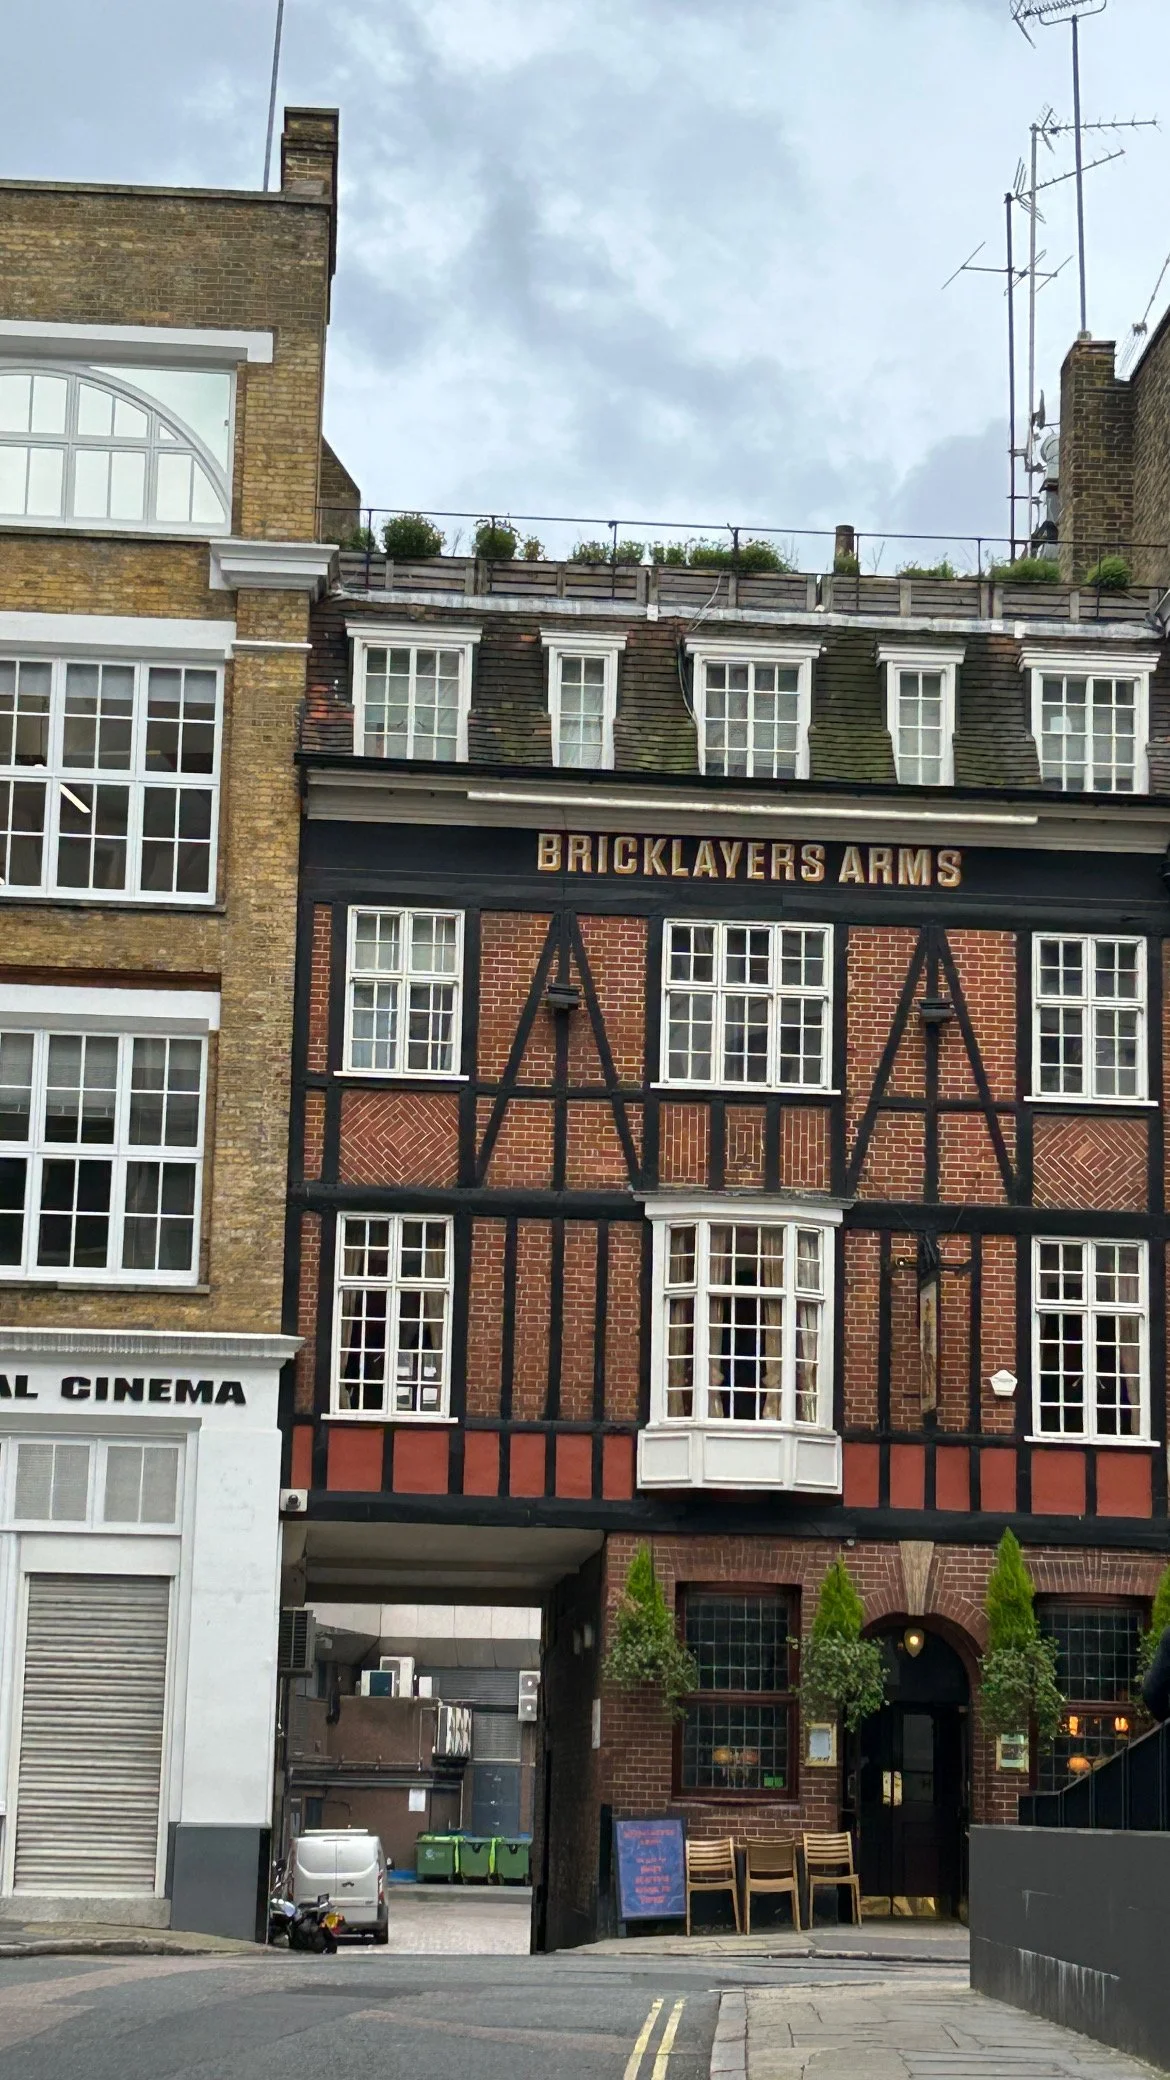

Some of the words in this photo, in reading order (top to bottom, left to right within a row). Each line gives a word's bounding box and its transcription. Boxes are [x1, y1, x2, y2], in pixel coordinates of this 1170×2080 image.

[538, 833, 825, 882] BRICKLAYERS
[839, 846, 962, 887] ARMS
[61, 1376, 246, 1404] CINEMA
